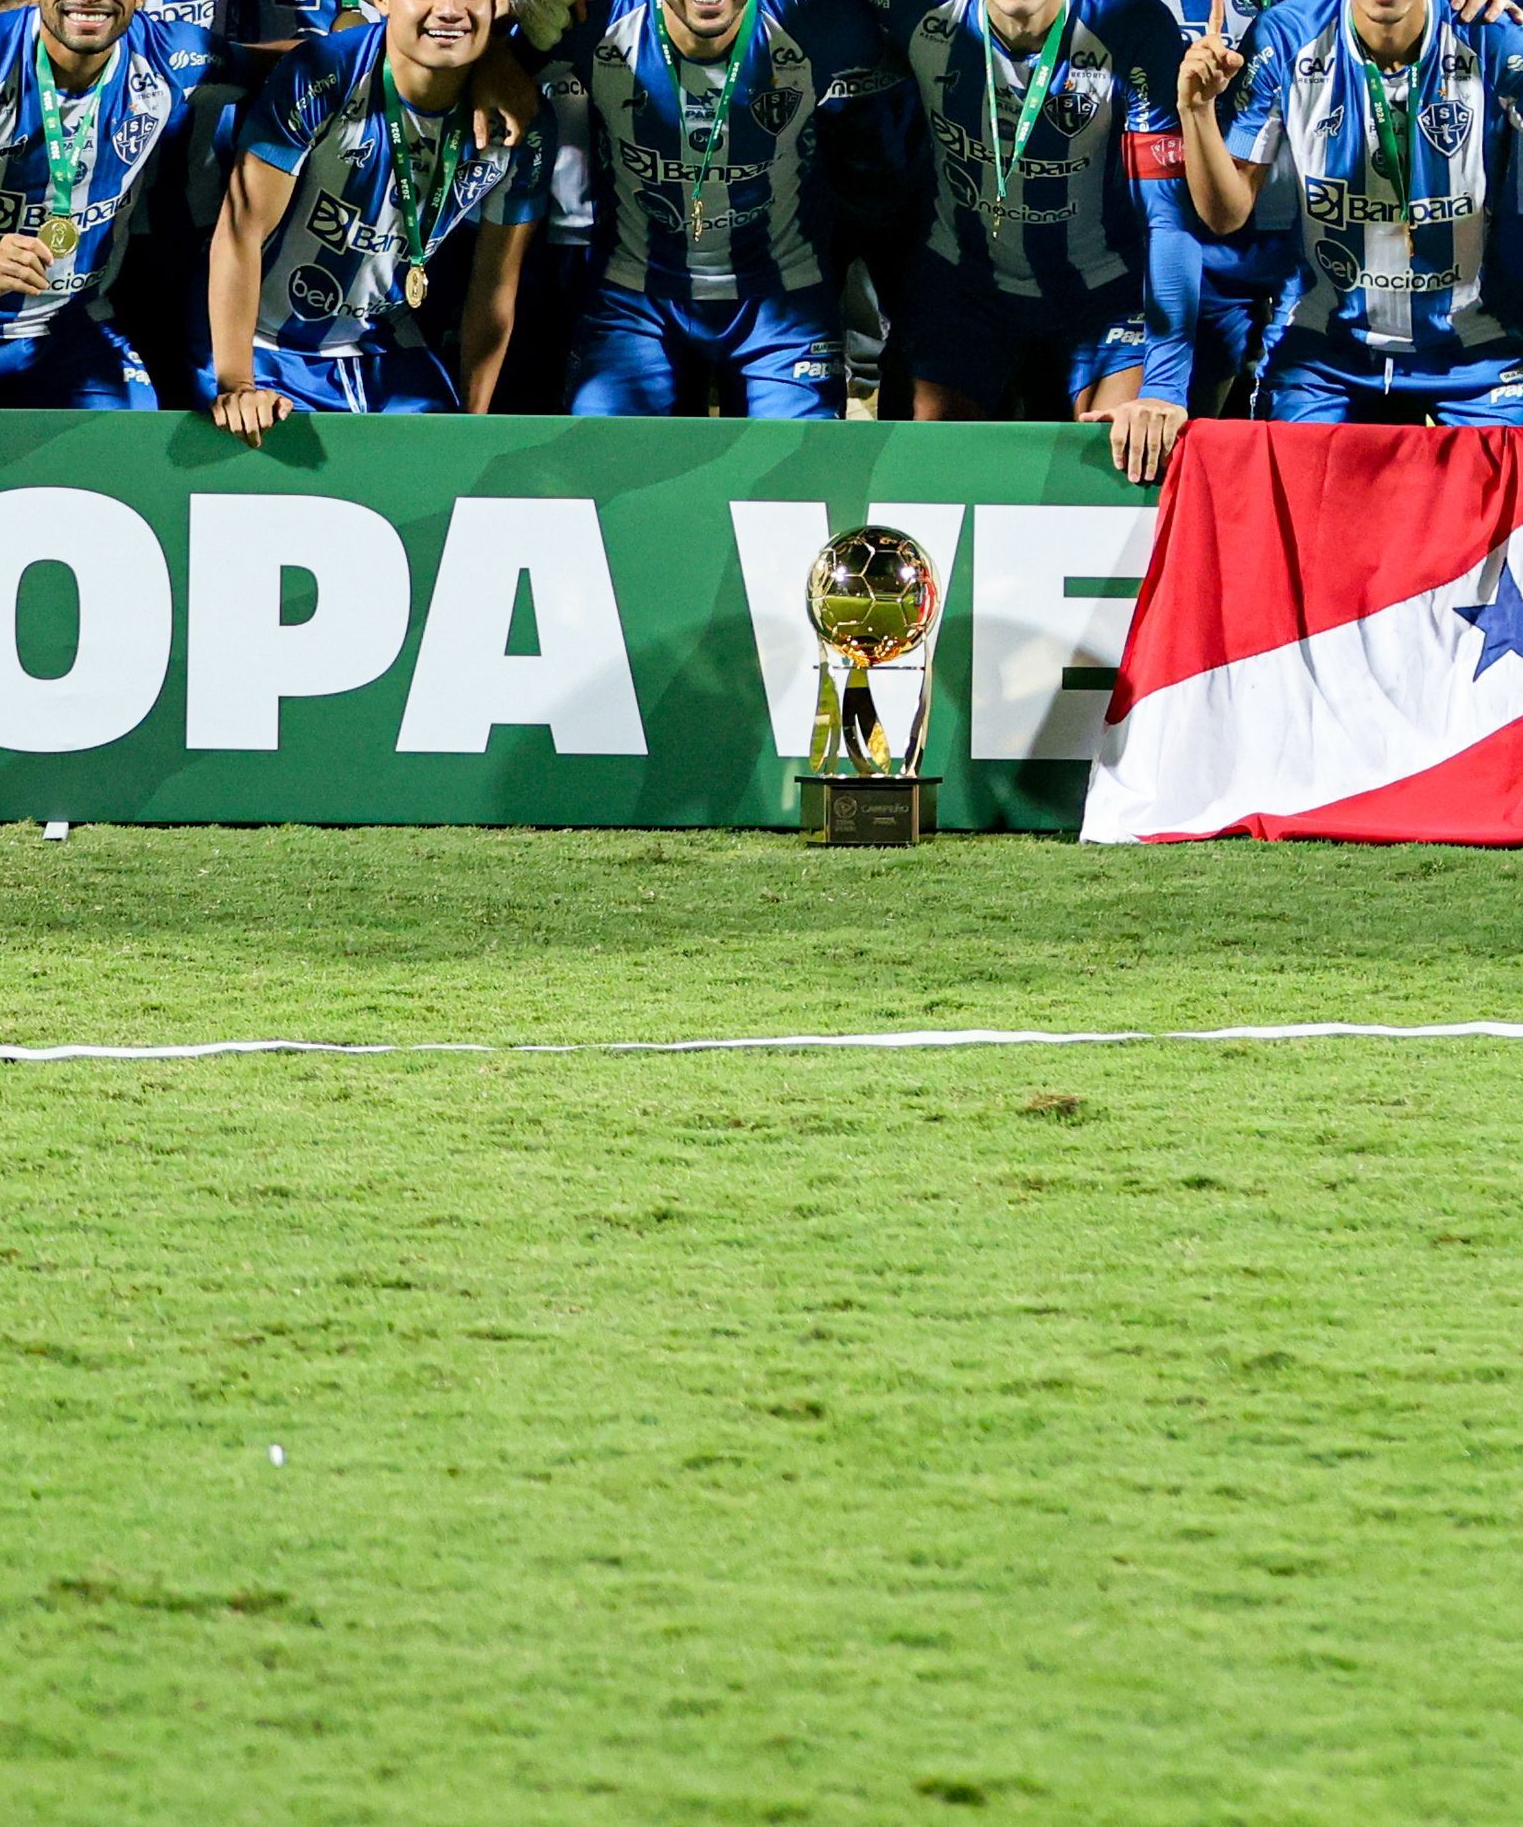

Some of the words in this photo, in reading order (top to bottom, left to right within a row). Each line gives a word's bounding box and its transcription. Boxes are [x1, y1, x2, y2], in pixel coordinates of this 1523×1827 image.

[922, 16, 959, 36] GAV
[594, 45, 631, 62] GAV
[662, 44, 673, 65] 2024
[772, 47, 806, 65] GAV
[1071, 50, 1108, 71] GAV
[729, 62, 741, 83] 2024
[1298, 57, 1333, 77] GAV
[1441, 54, 1476, 75] GAV
[1036, 65, 1049, 88] 2024
[1071, 72, 1107, 80] RESORTS
[42, 90, 52, 112] 2024
[1373, 102, 1385, 124] 2024
[1423, 106, 1467, 126] PSC
[391, 121, 402, 145] 2024
[449, 129, 462, 152] 2024
[1019, 121, 1032, 142] 2024
[401, 177, 411, 200] 2024
[431, 187, 443, 209] 2024
[1318, 247, 1355, 284] bet
[1360, 264, 1461, 291] nacional
[291, 270, 337, 310] bet
